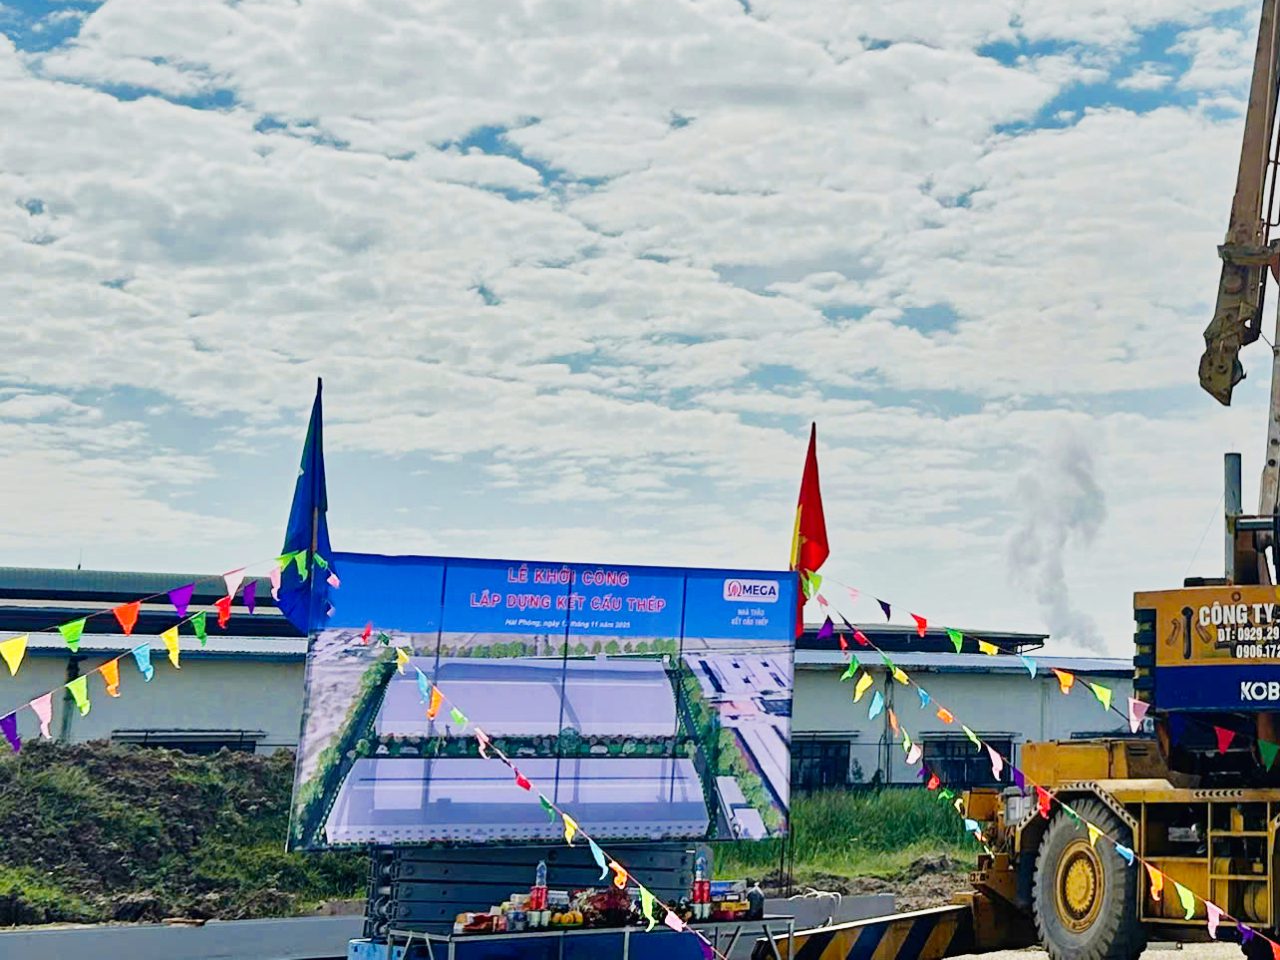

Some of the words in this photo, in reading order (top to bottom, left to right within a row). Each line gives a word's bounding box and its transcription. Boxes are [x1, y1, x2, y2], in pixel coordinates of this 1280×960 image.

[507, 564, 528, 583] LỄ
[534, 565, 576, 585] KHỞI
[582, 567, 630, 587] CÔNG
[470, 589, 502, 608] LẮP
[506, 593, 551, 612] DỰNG
[555, 591, 586, 610] KẾT
[590, 592, 622, 612] CẤU
[627, 595, 666, 613] THÉP
[1198, 602, 1248, 626] CÔNG
